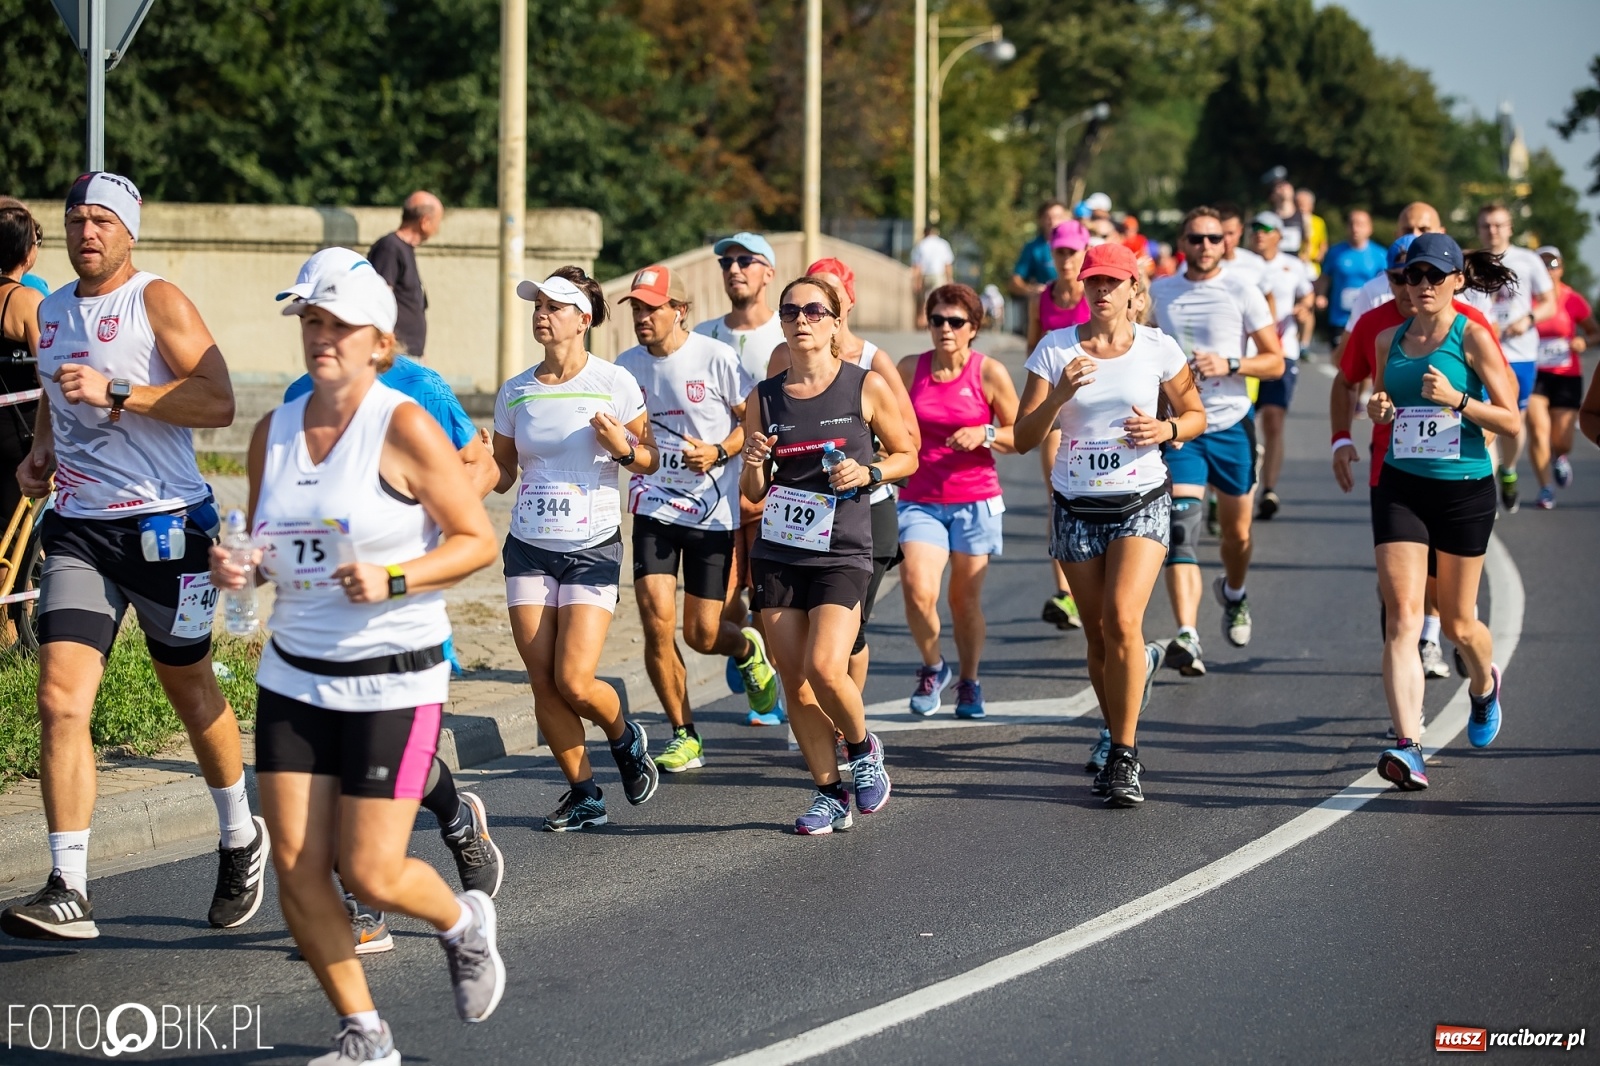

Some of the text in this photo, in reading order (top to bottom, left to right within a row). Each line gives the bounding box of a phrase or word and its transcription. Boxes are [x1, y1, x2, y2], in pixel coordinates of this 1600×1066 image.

[1418, 420, 1437, 437] 18
[778, 446, 806, 454] FESTIWAL
[662, 452, 688, 470] 165
[1088, 453, 1120, 471] 108
[536, 498, 572, 517] 344
[784, 503, 816, 527] 129
[293, 539, 326, 564] 75
[200, 587, 220, 611] 40
